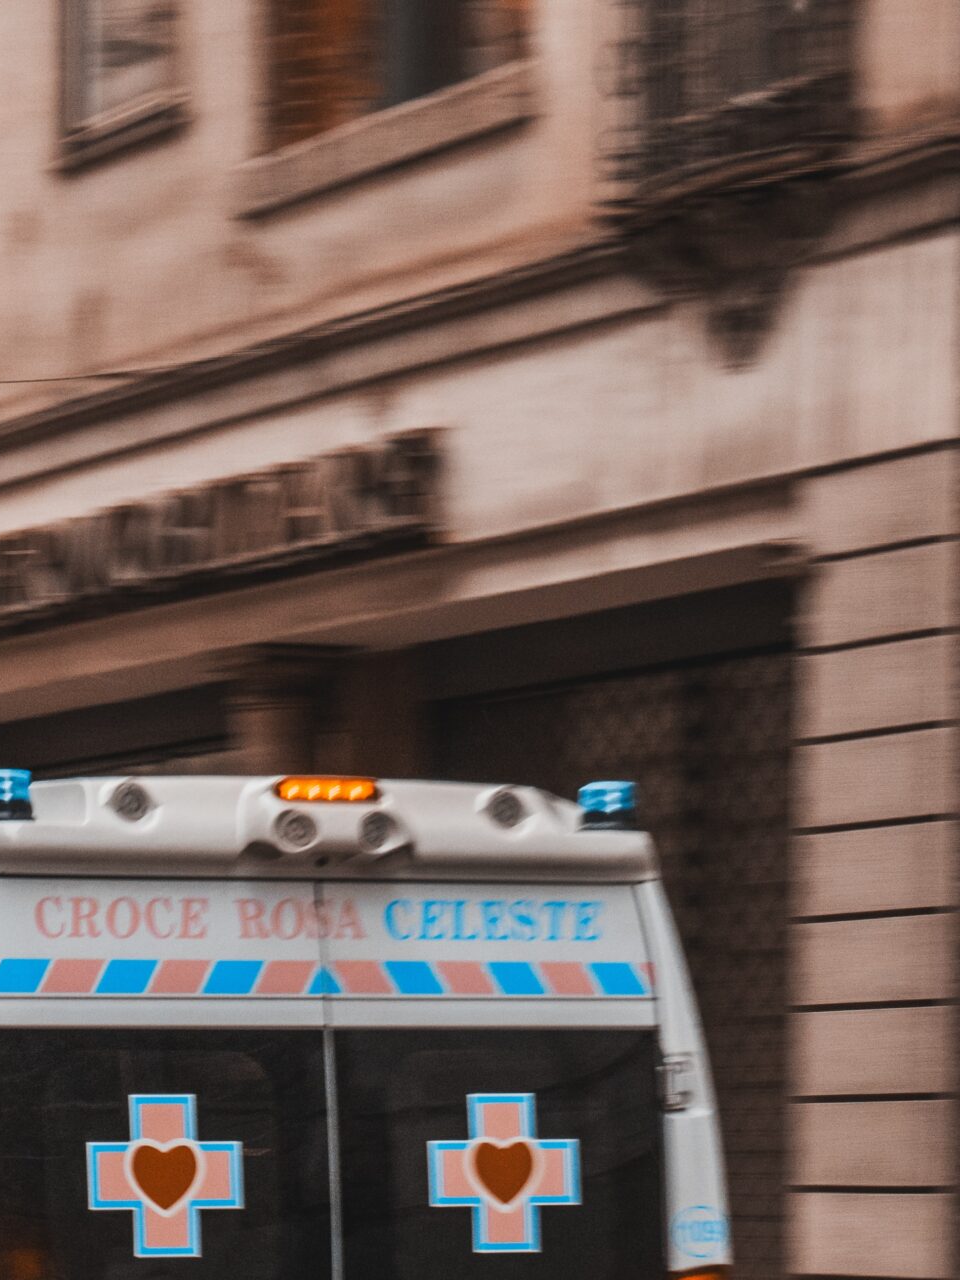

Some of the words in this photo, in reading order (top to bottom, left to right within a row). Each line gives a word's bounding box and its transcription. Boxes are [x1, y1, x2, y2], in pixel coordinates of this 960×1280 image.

[32, 896, 209, 939] CROCE
[233, 896, 368, 940] ROSA
[383, 900, 606, 943] CELESTE
